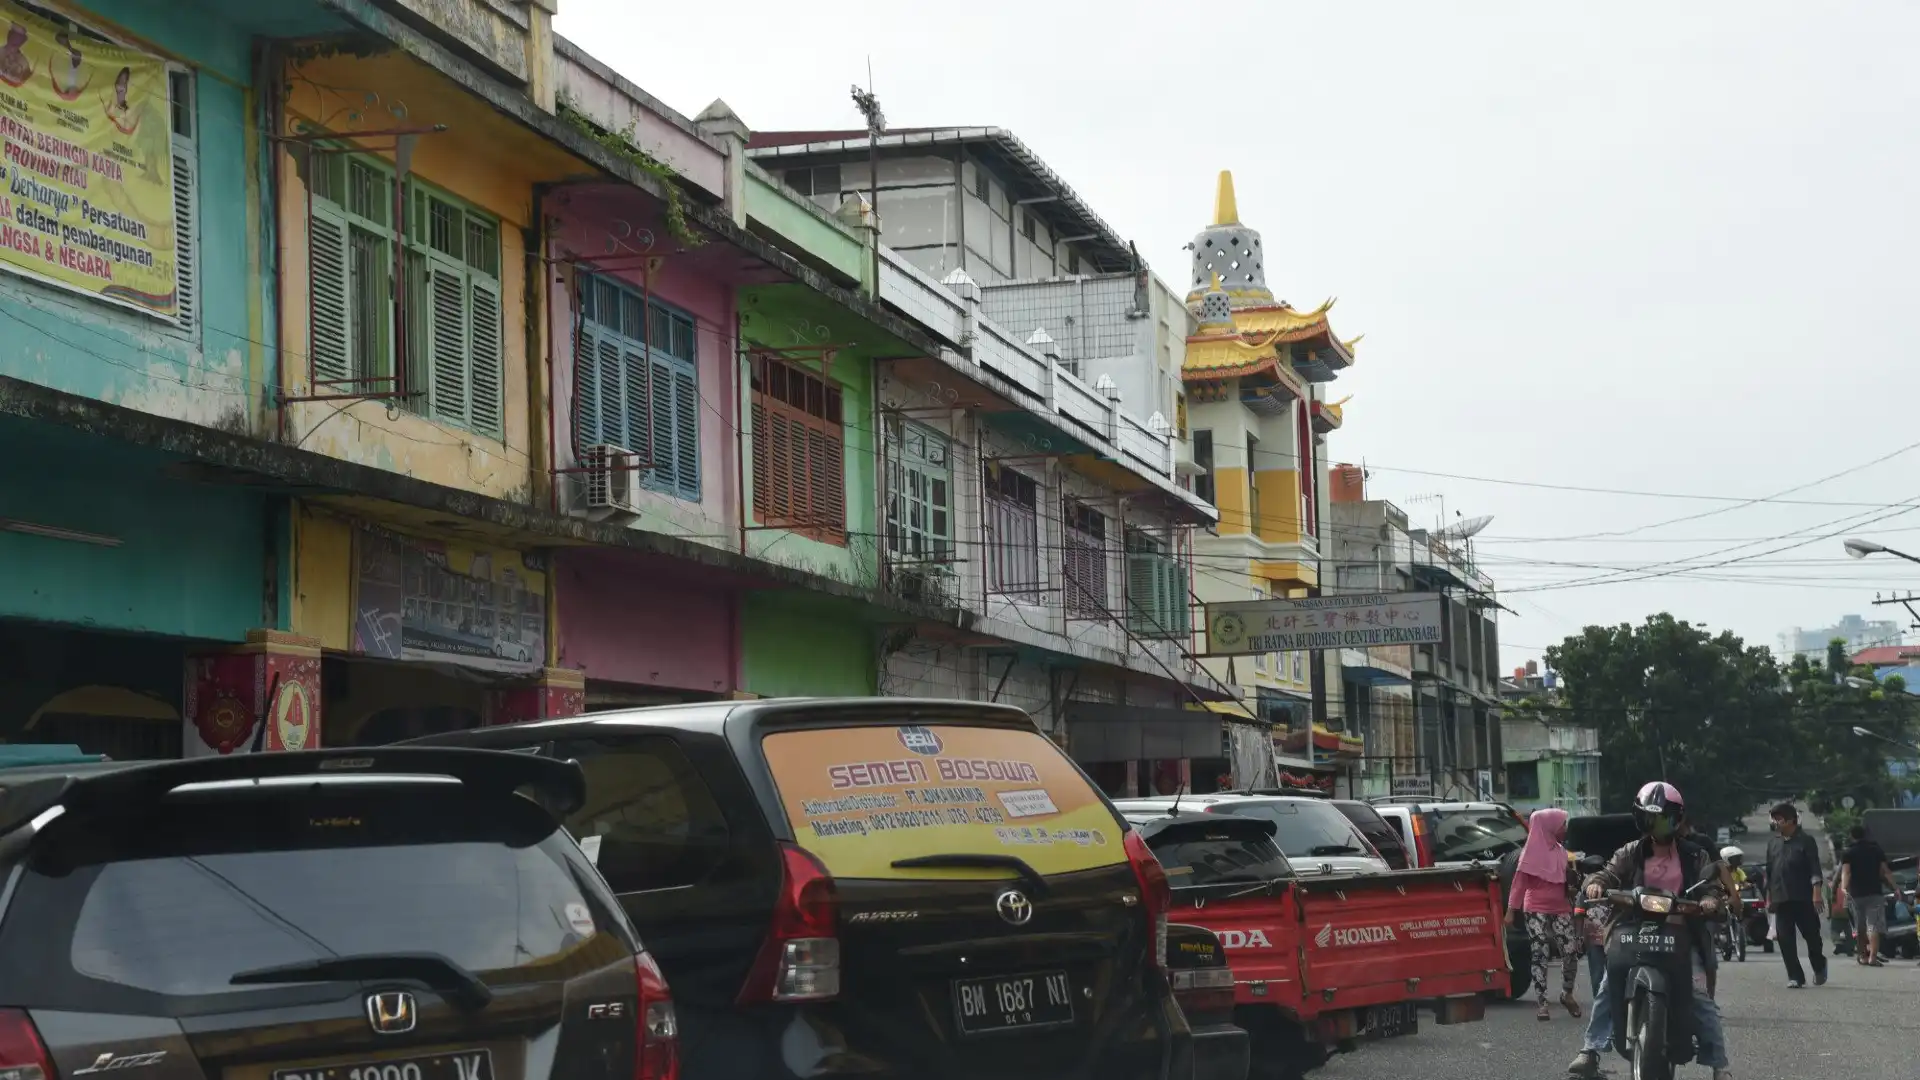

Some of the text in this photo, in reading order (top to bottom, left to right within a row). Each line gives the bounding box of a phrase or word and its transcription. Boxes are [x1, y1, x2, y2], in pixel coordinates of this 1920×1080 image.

[4, 140, 88, 189] PROVINSI RIAU
[36, 131, 89, 168] BERINGIN
[10, 165, 69, 218] Berkarya
[81, 199, 147, 239] Persatuan
[15, 203, 59, 237] dalam
[62, 222, 153, 267] pembangunan
[44, 240, 55, 262] &
[58, 244, 113, 281] NEGARA
[1247, 625, 1440, 651] TRI RATNA BUDDHIST CENTRE PEKANBARU
[828, 758, 1040, 789] SEMEN BOSOWA
[802, 797, 850, 815] Authorized
[850, 793, 898, 811] Distributor
[811, 817, 868, 837] Marketing
[869, 813, 895, 831] 0812
[895, 811, 920, 829] 6820
[1333, 925, 1397, 947] HONDA
[1620, 934, 1633, 944] BM
[1639, 935, 1660, 944] 2577
[961, 975, 1070, 1017] BM 1687 NI
